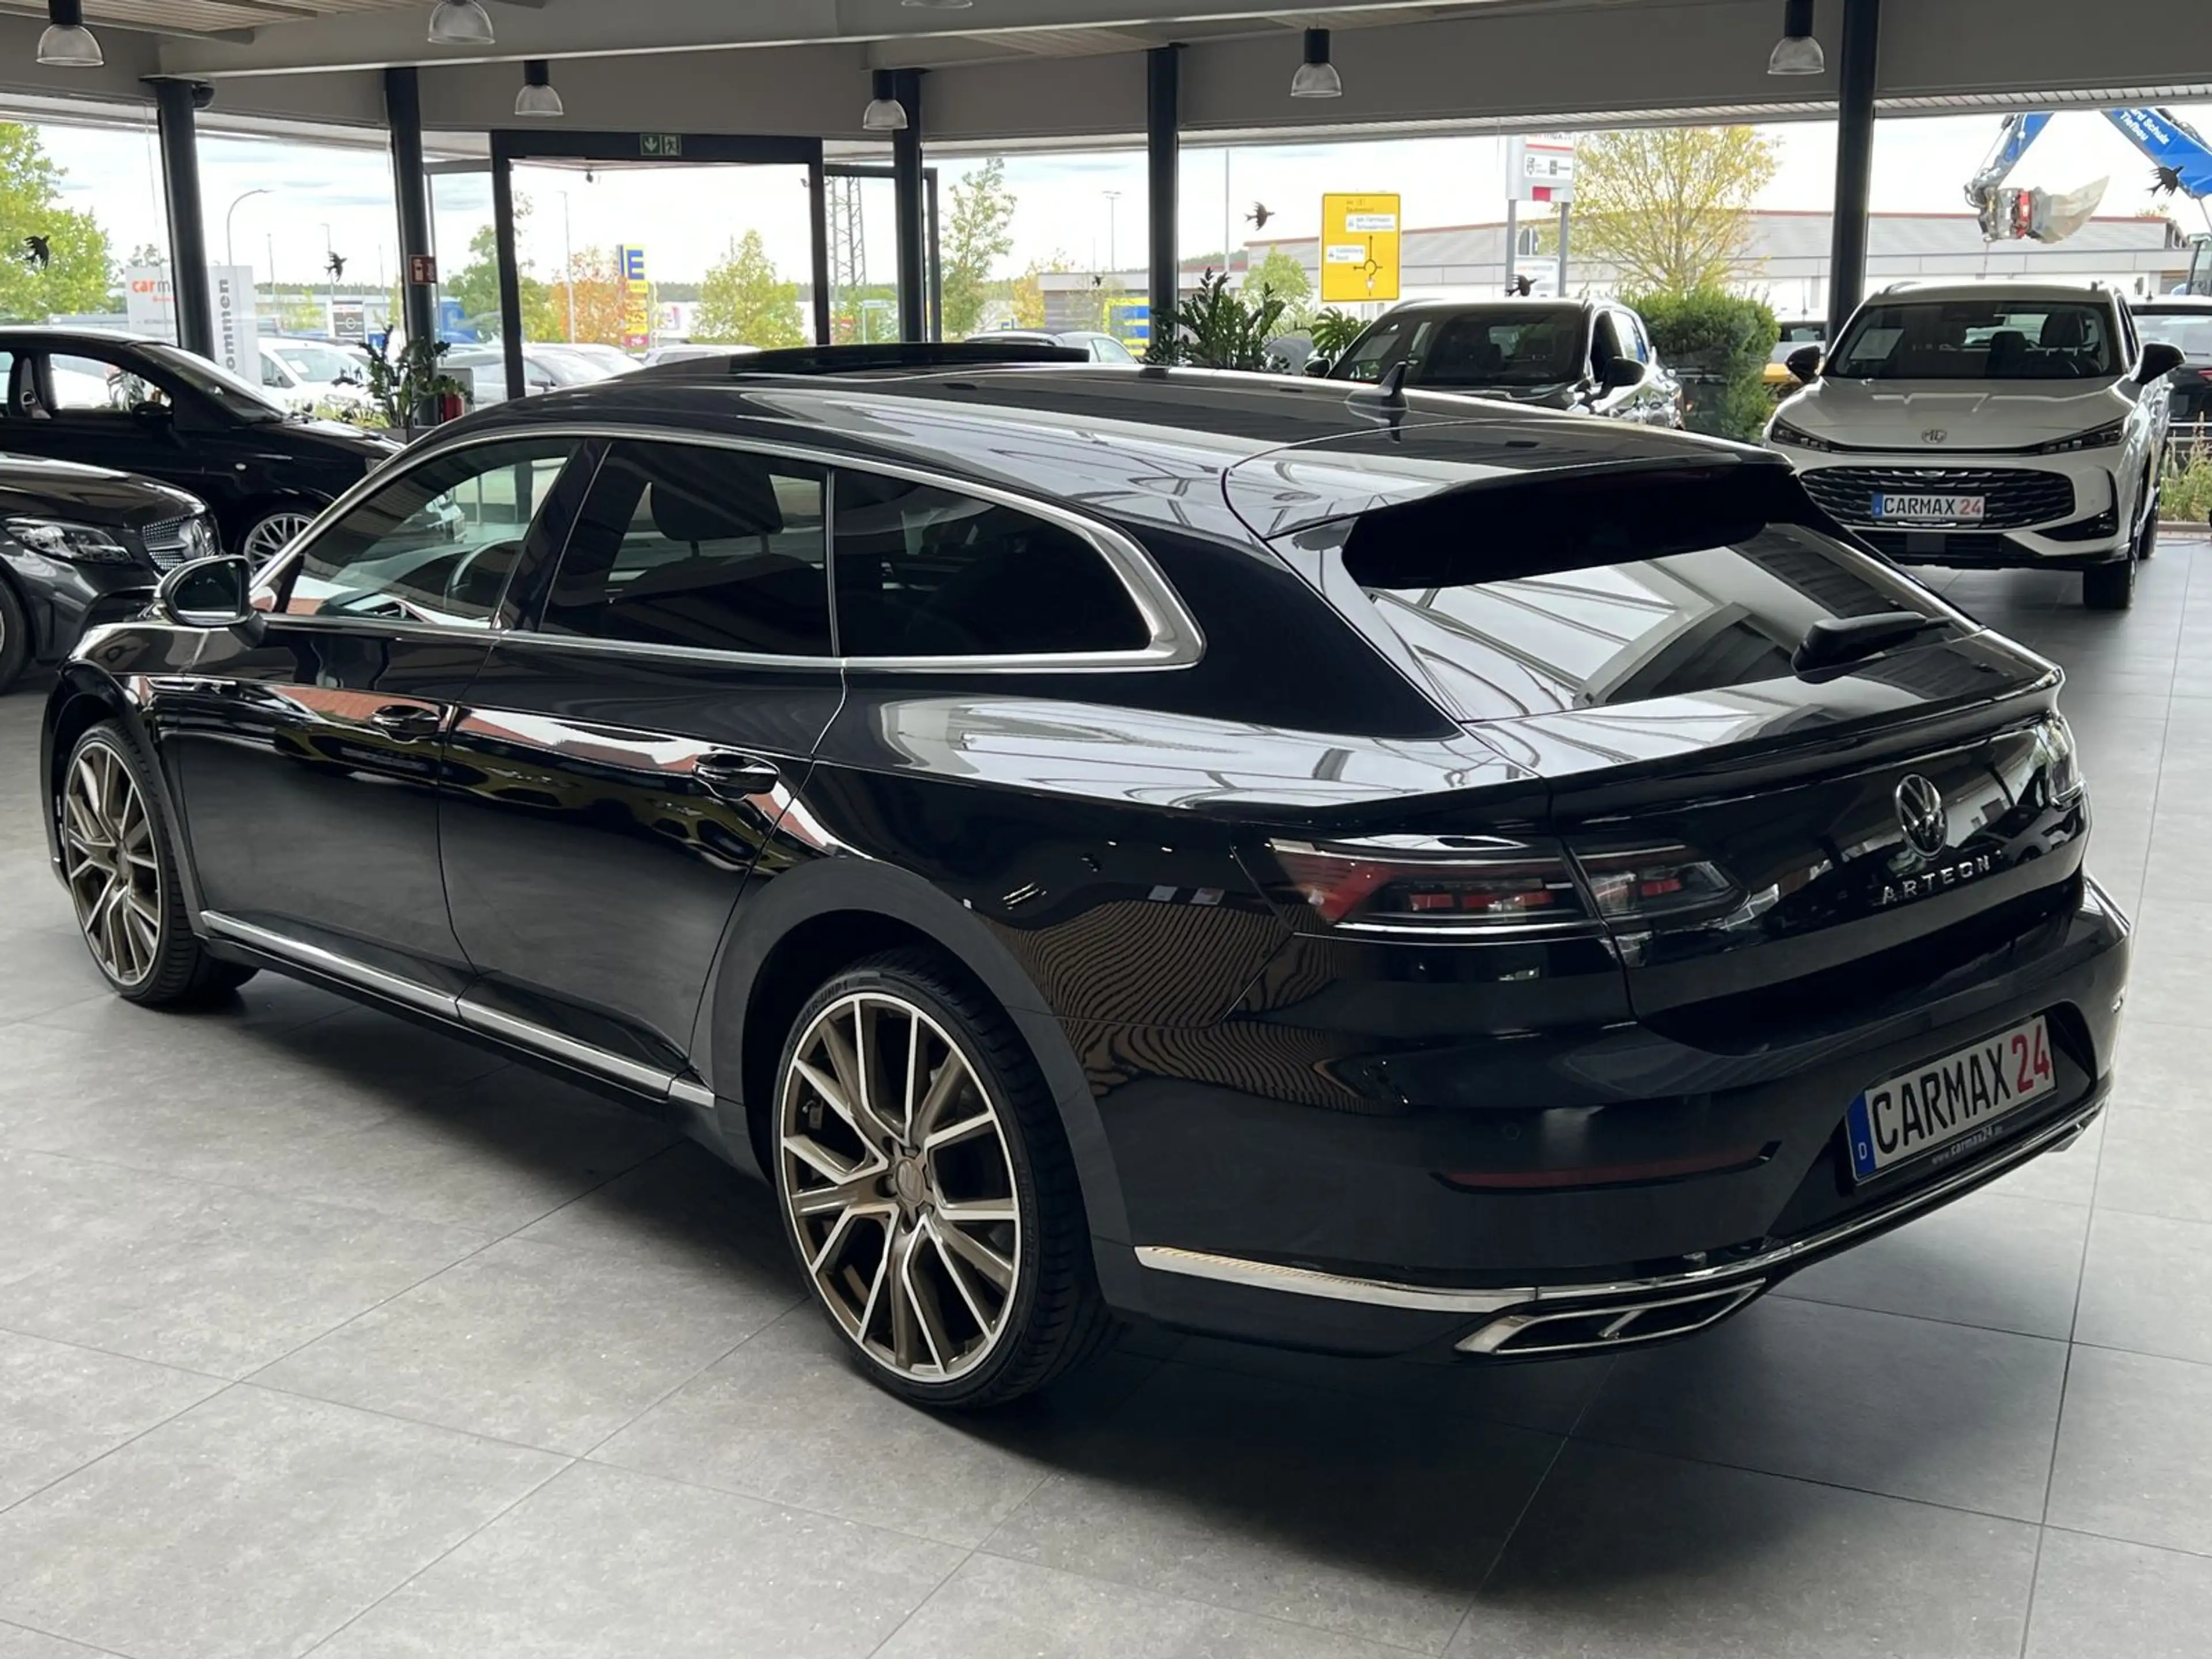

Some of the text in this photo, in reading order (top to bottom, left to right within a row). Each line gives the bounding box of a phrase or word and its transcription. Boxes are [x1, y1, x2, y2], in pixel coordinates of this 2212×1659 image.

[2120, 110, 2149, 141] Tiefbau
[627, 250, 645, 279] E
[219, 279, 236, 374] ommen
[1922, 429, 1947, 444] MG
[1882, 854, 1990, 904] ARTEON
[1858, 1142, 1868, 1160] D
